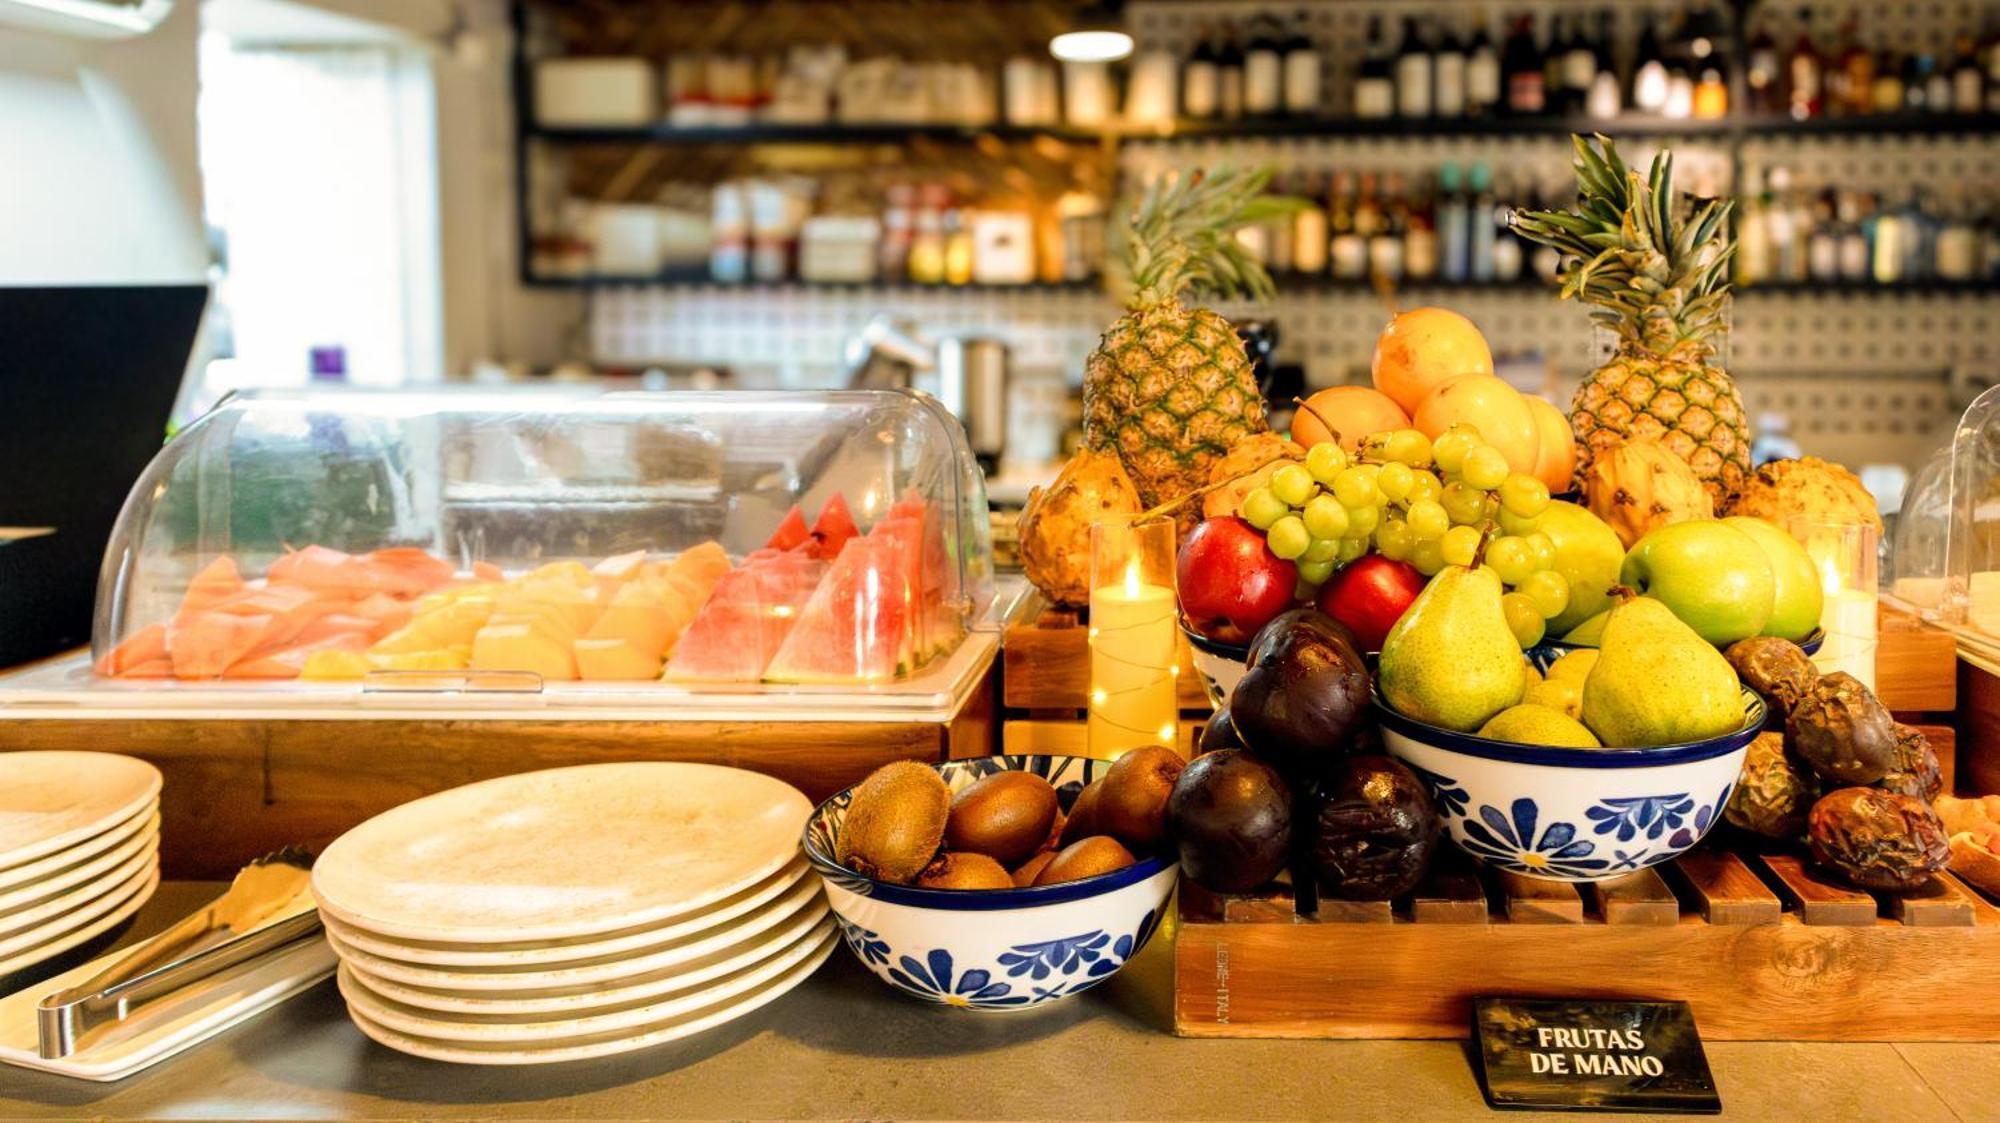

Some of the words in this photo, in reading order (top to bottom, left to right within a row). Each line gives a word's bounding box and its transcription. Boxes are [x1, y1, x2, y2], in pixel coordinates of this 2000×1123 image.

[1537, 1027, 1645, 1050] FRUTAS
[1530, 1053, 1569, 1074] DE
[1574, 1054, 1664, 1076] MANO
